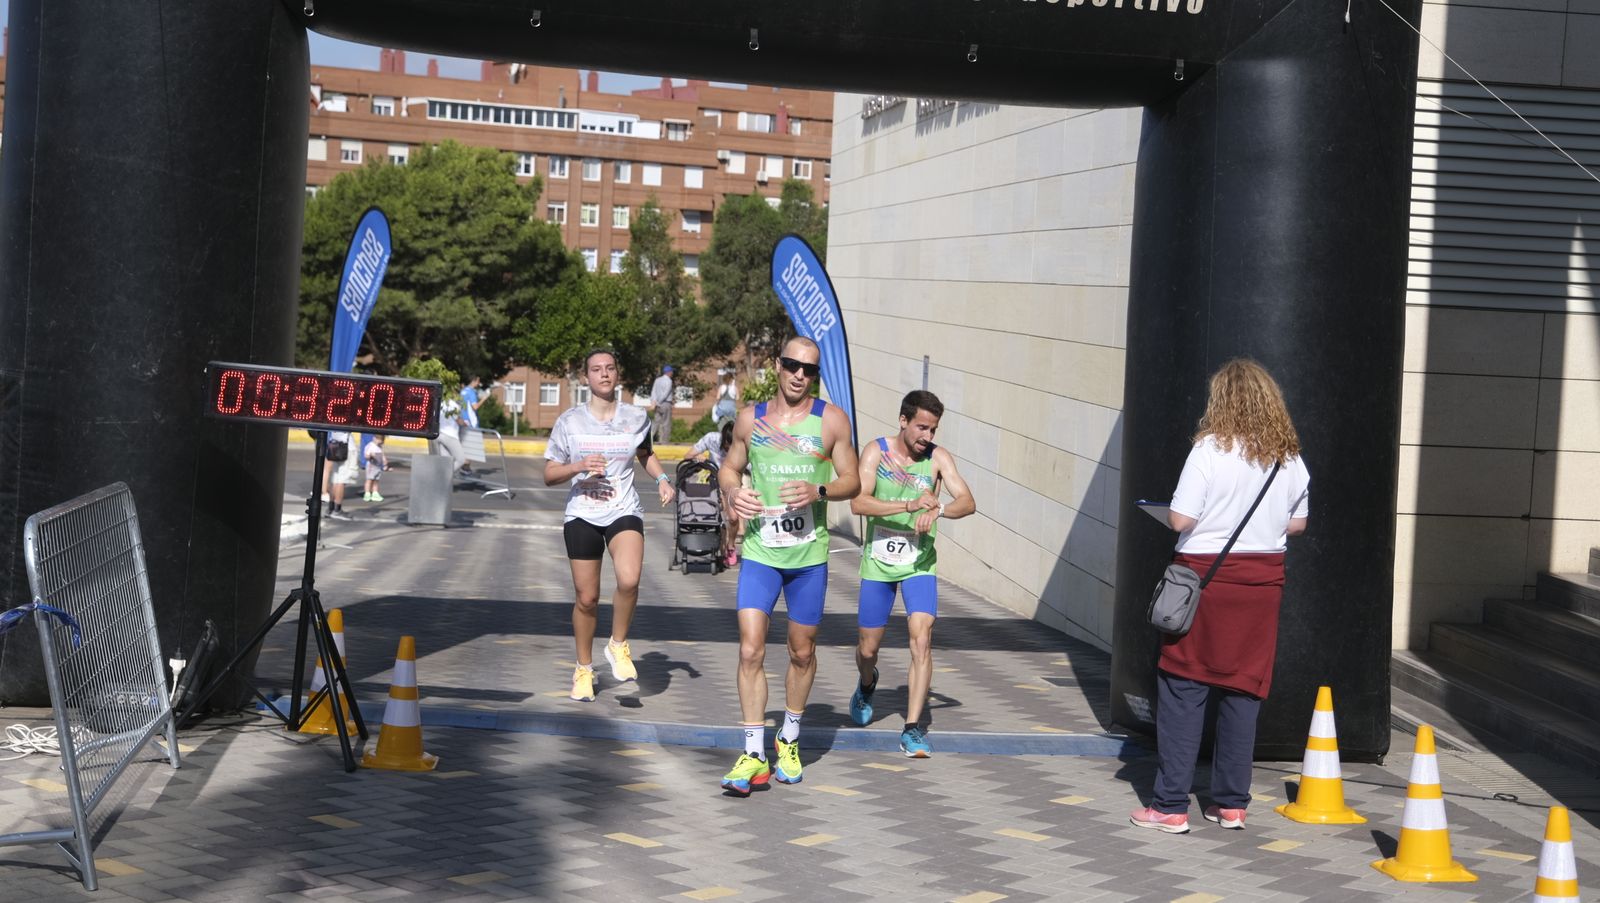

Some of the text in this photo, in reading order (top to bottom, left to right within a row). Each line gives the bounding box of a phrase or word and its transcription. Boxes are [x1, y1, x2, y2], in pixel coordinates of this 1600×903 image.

[341, 227, 384, 322] sanchez
[770, 464, 815, 474] SAKATA
[771, 516, 805, 533] 100
[886, 541, 907, 553] 67
